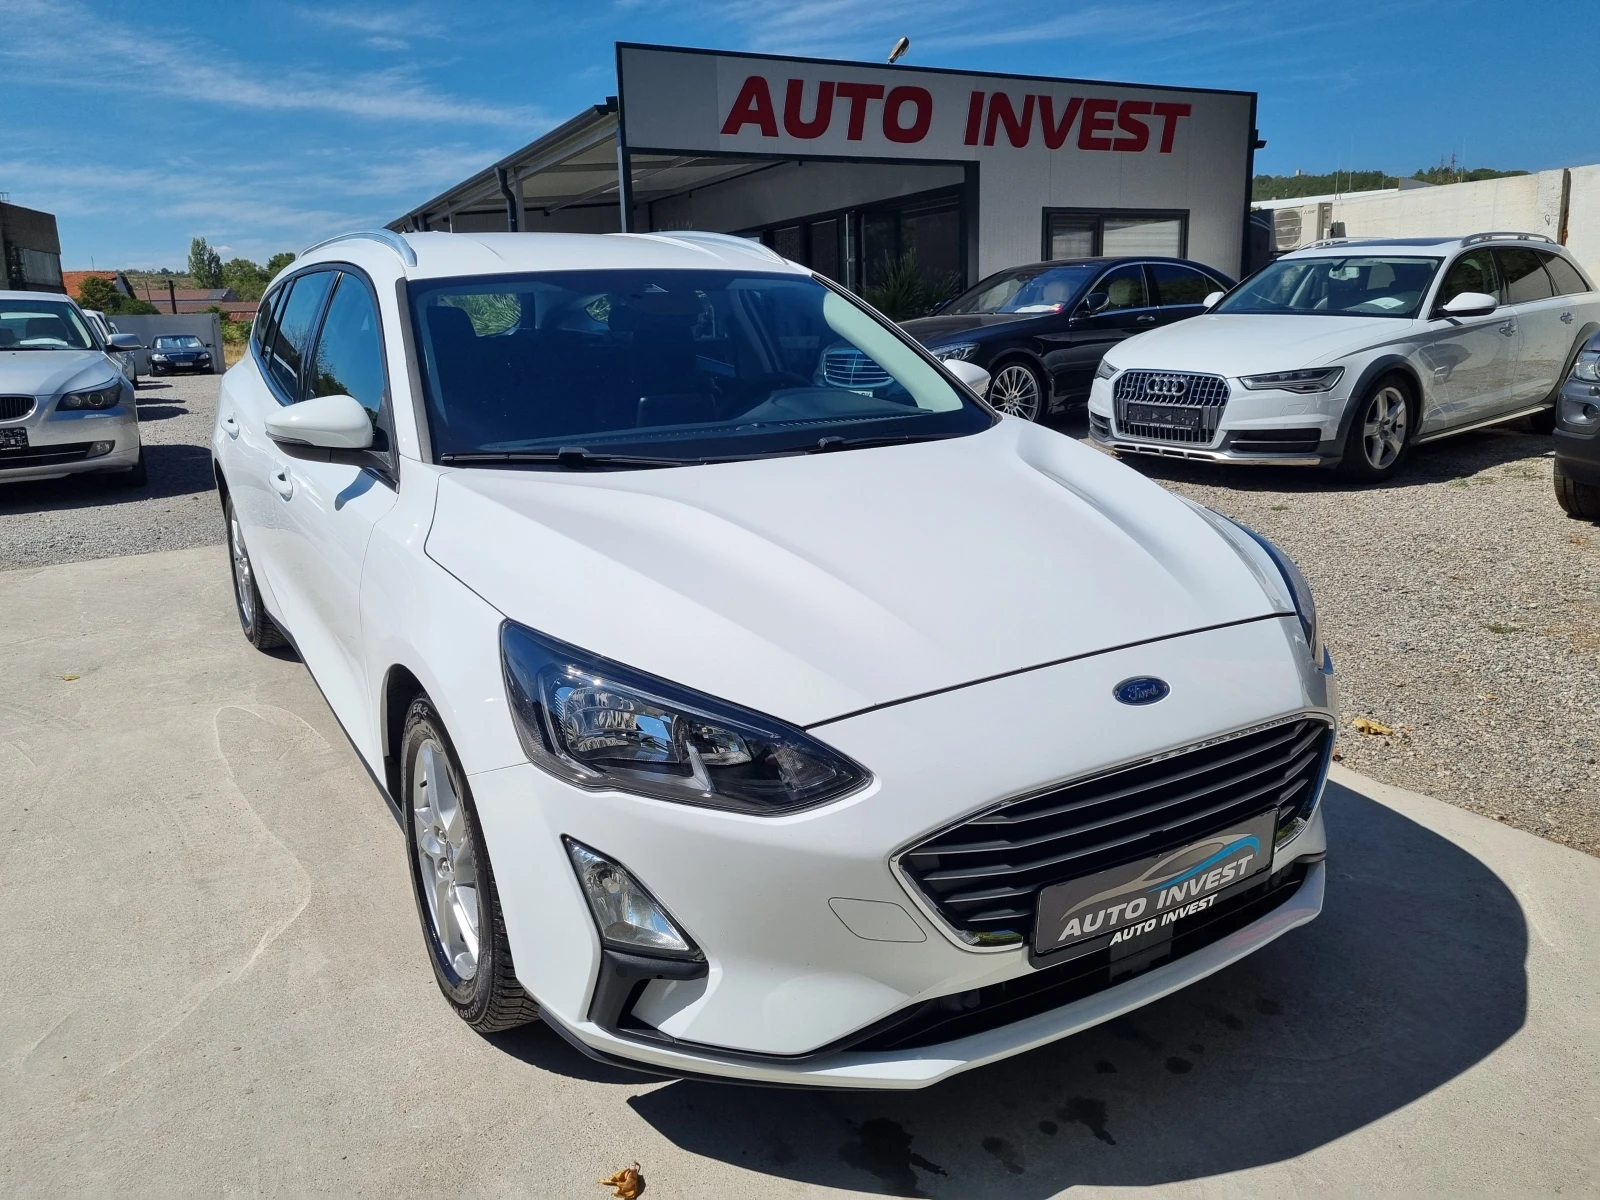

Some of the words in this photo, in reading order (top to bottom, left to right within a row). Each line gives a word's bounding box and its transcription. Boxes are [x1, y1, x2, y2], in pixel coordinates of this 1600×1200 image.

[720, 75, 933, 143] AUTO
[963, 91, 1192, 154] INVEST
[1127, 683, 1159, 701] Ford
[1057, 897, 1148, 942] AUTO
[1156, 854, 1254, 910] INVEST
[1109, 918, 1157, 946] AUTO
[1160, 894, 1218, 927] INVEST
